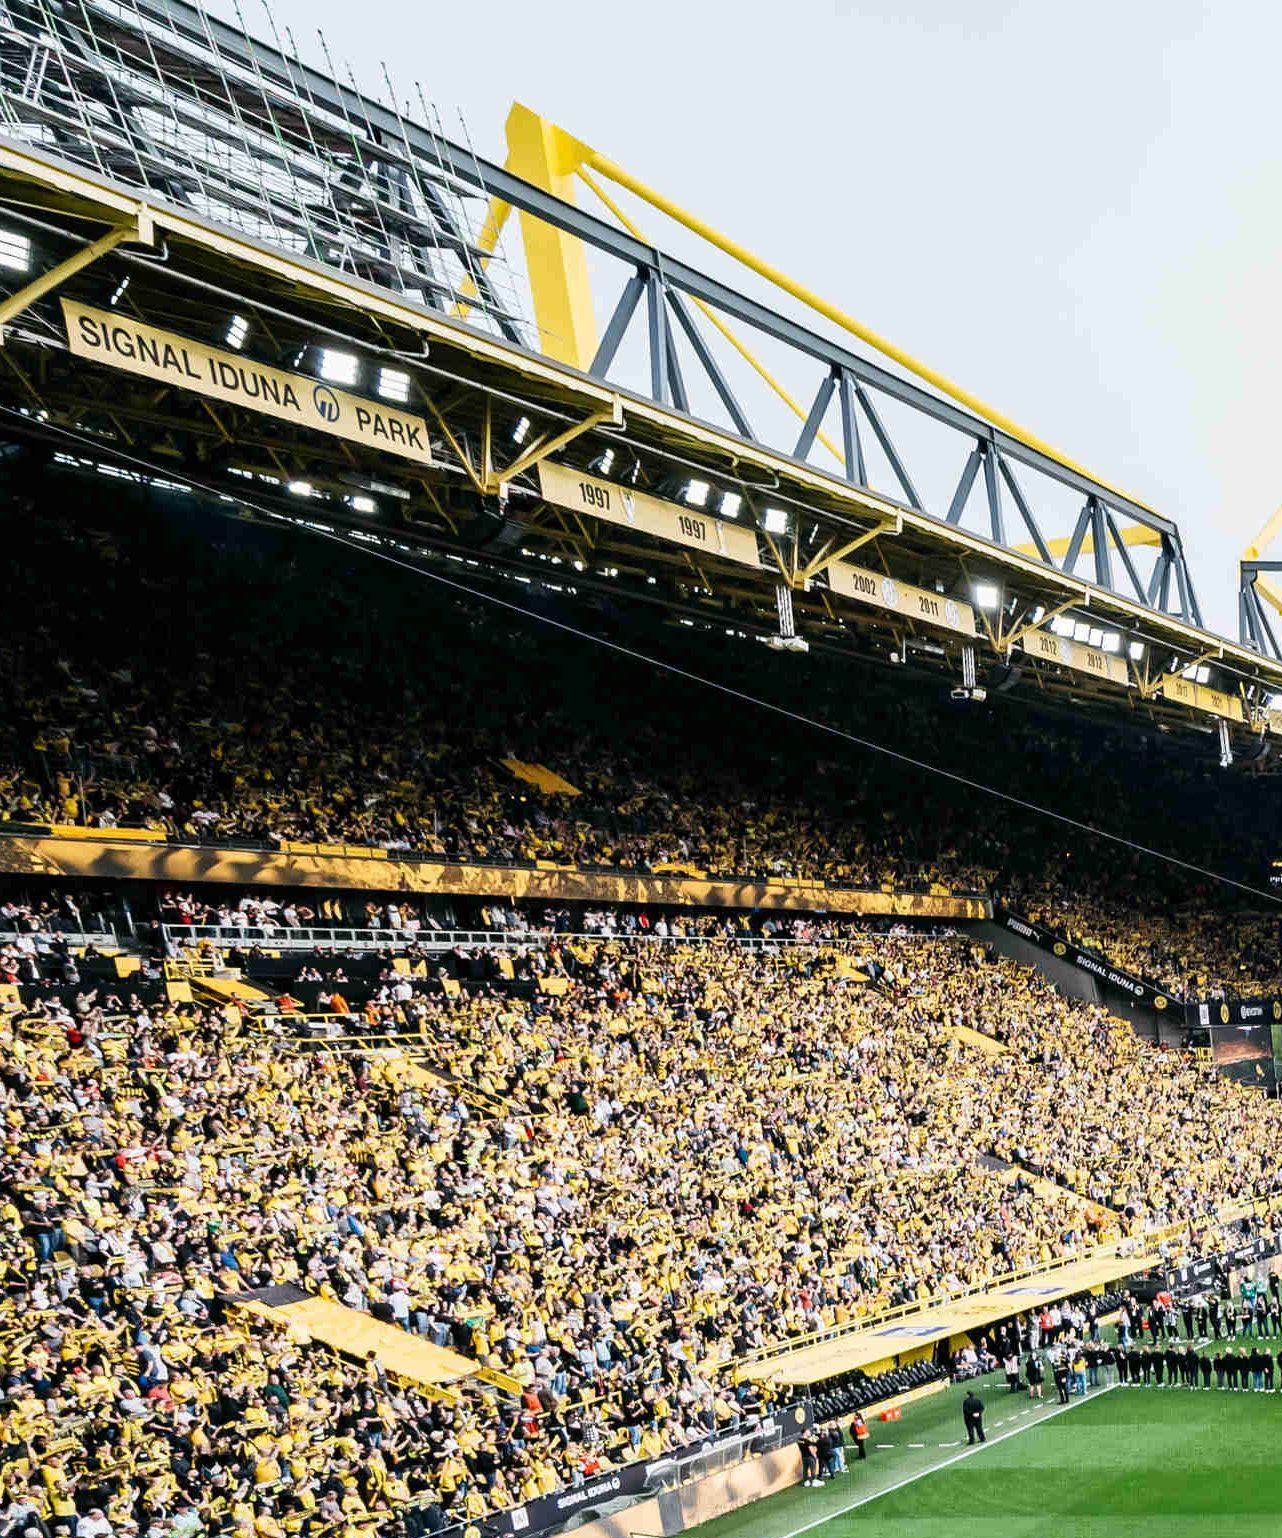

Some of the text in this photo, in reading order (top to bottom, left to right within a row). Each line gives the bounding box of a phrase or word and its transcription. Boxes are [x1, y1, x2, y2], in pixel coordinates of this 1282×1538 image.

[78, 315, 425, 450] SIGNAL IDUNA PARK
[579, 482, 706, 542] 1997 1997
[852, 573, 939, 617] 2002 2011
[1039, 637, 1059, 656] 2012
[1076, 955, 1136, 993] SIGNAL IDUNA
